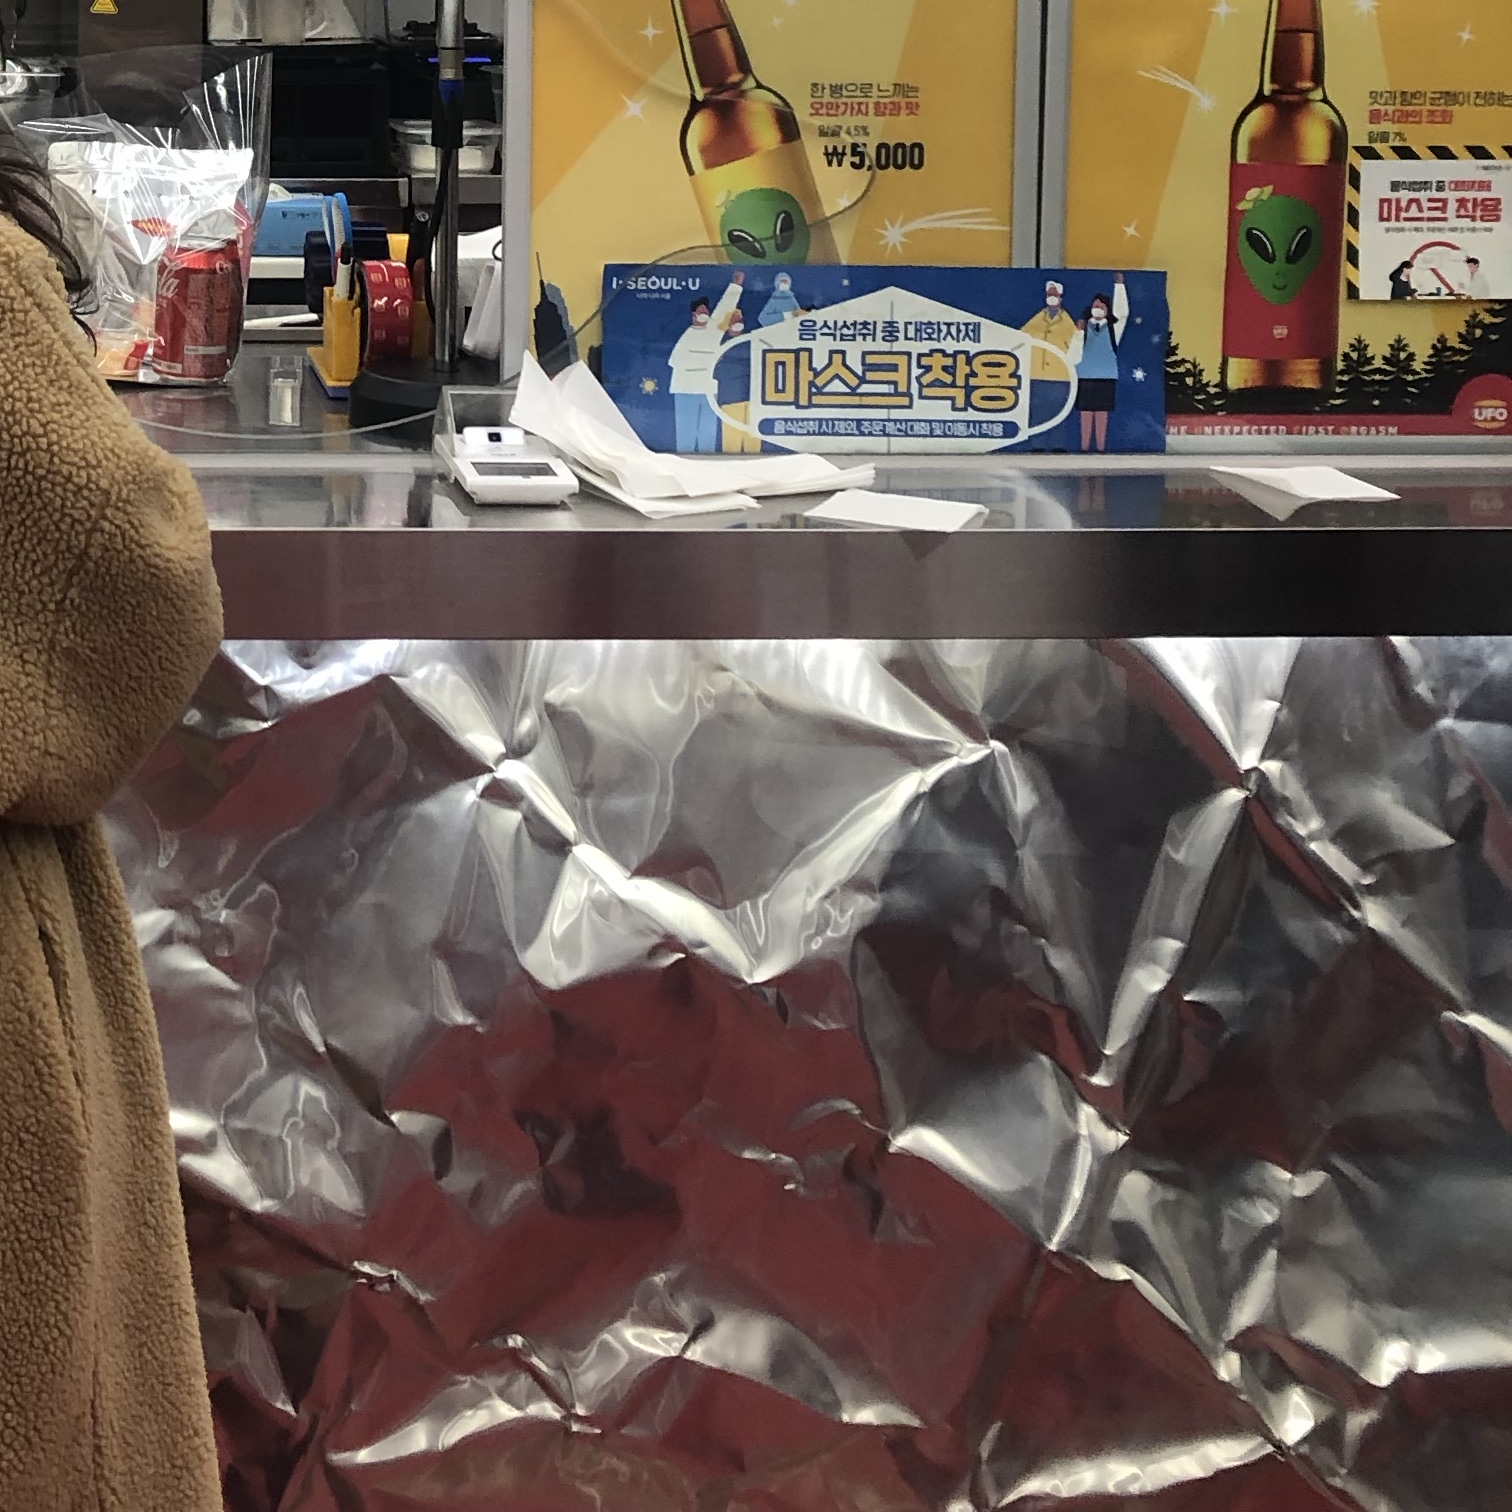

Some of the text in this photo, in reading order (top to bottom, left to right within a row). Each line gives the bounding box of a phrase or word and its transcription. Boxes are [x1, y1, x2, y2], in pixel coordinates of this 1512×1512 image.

[810, 82, 827, 98] 한
[829, 82, 874, 98] 병으로
[809, 101, 921, 117] 오만가지 향과 맛
[824, 141, 925, 171] ₩5,000
[1378, 197, 1502, 223] 마스크 착용
[797, 319, 982, 344] 음식섭취 중 대화자제
[761, 347, 1022, 413] 마스크 착용
[1473, 408, 1508, 421] UFO
